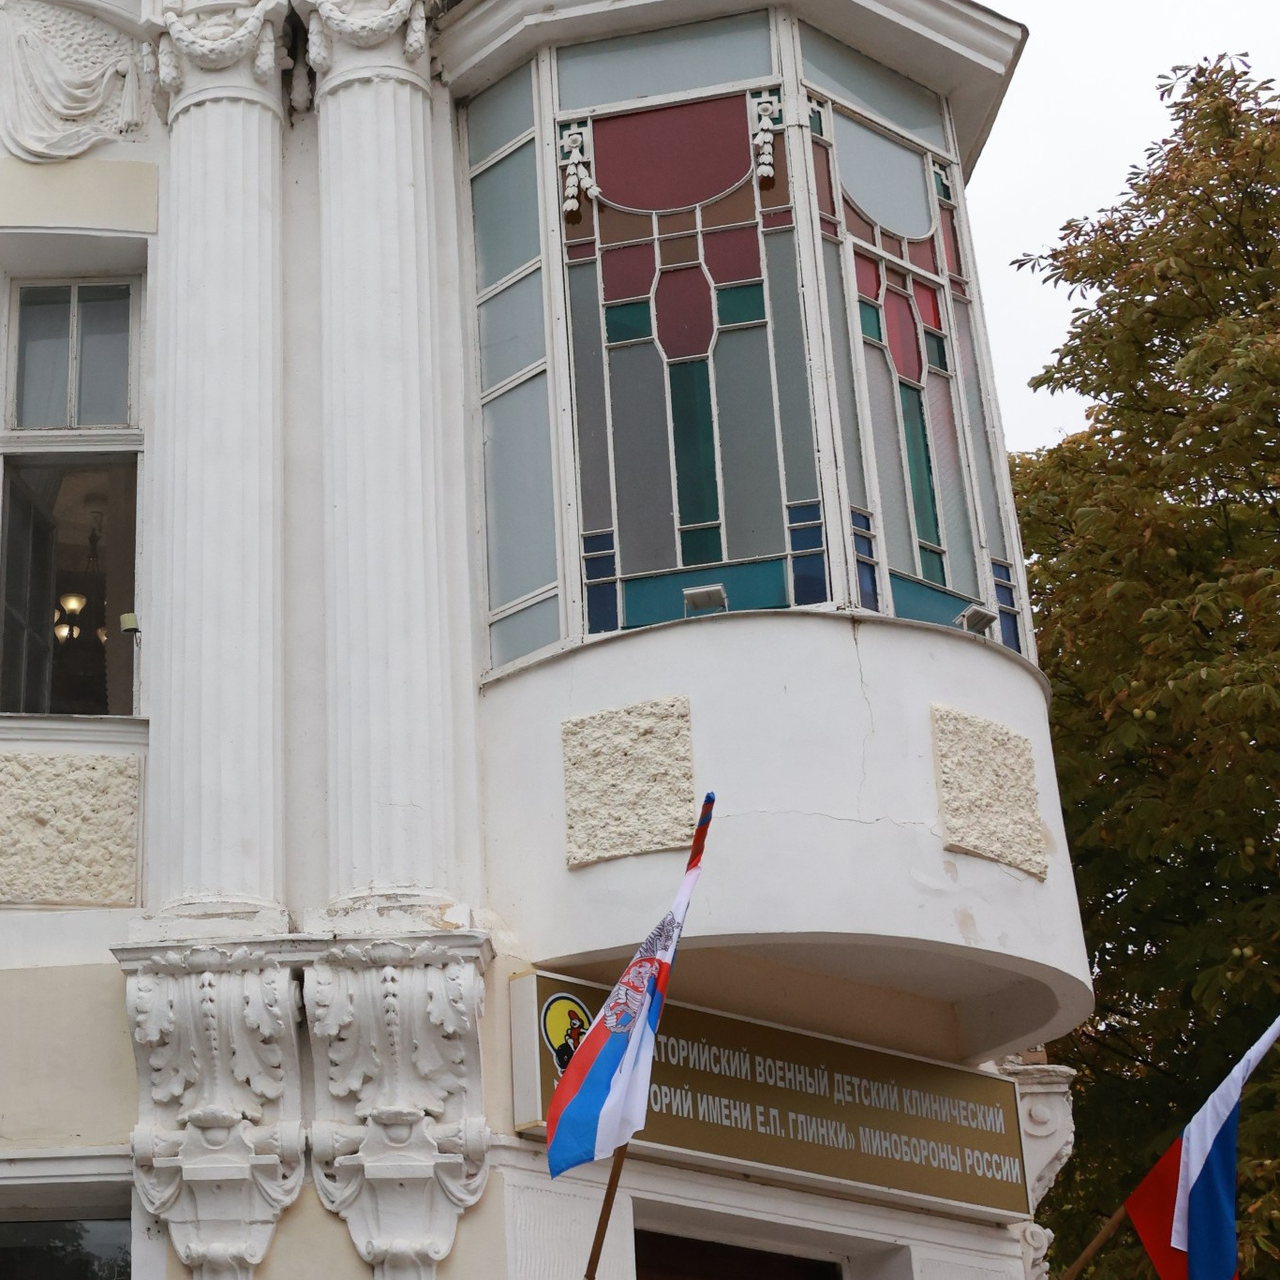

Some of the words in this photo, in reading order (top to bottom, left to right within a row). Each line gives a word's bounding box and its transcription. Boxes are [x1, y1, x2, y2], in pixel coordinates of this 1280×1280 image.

[652, 1034, 751, 1081] ТОРИЙСКИЙ
[754, 1055, 830, 1097] ВОЕННЫЙ
[833, 1072, 900, 1112] ДЕТСКИЙ
[902, 1088, 1006, 1134] КЛИНИЧЕСКИЙ
[697, 1092, 753, 1131] ИМЕНИ
[755, 1104, 786, 1137] Е.П.
[788, 1111, 856, 1151] ГЛИНКИ»
[858, 1125, 963, 1173] МИНОБОРОНЫ
[964, 1148, 1022, 1184] РОССИИ
